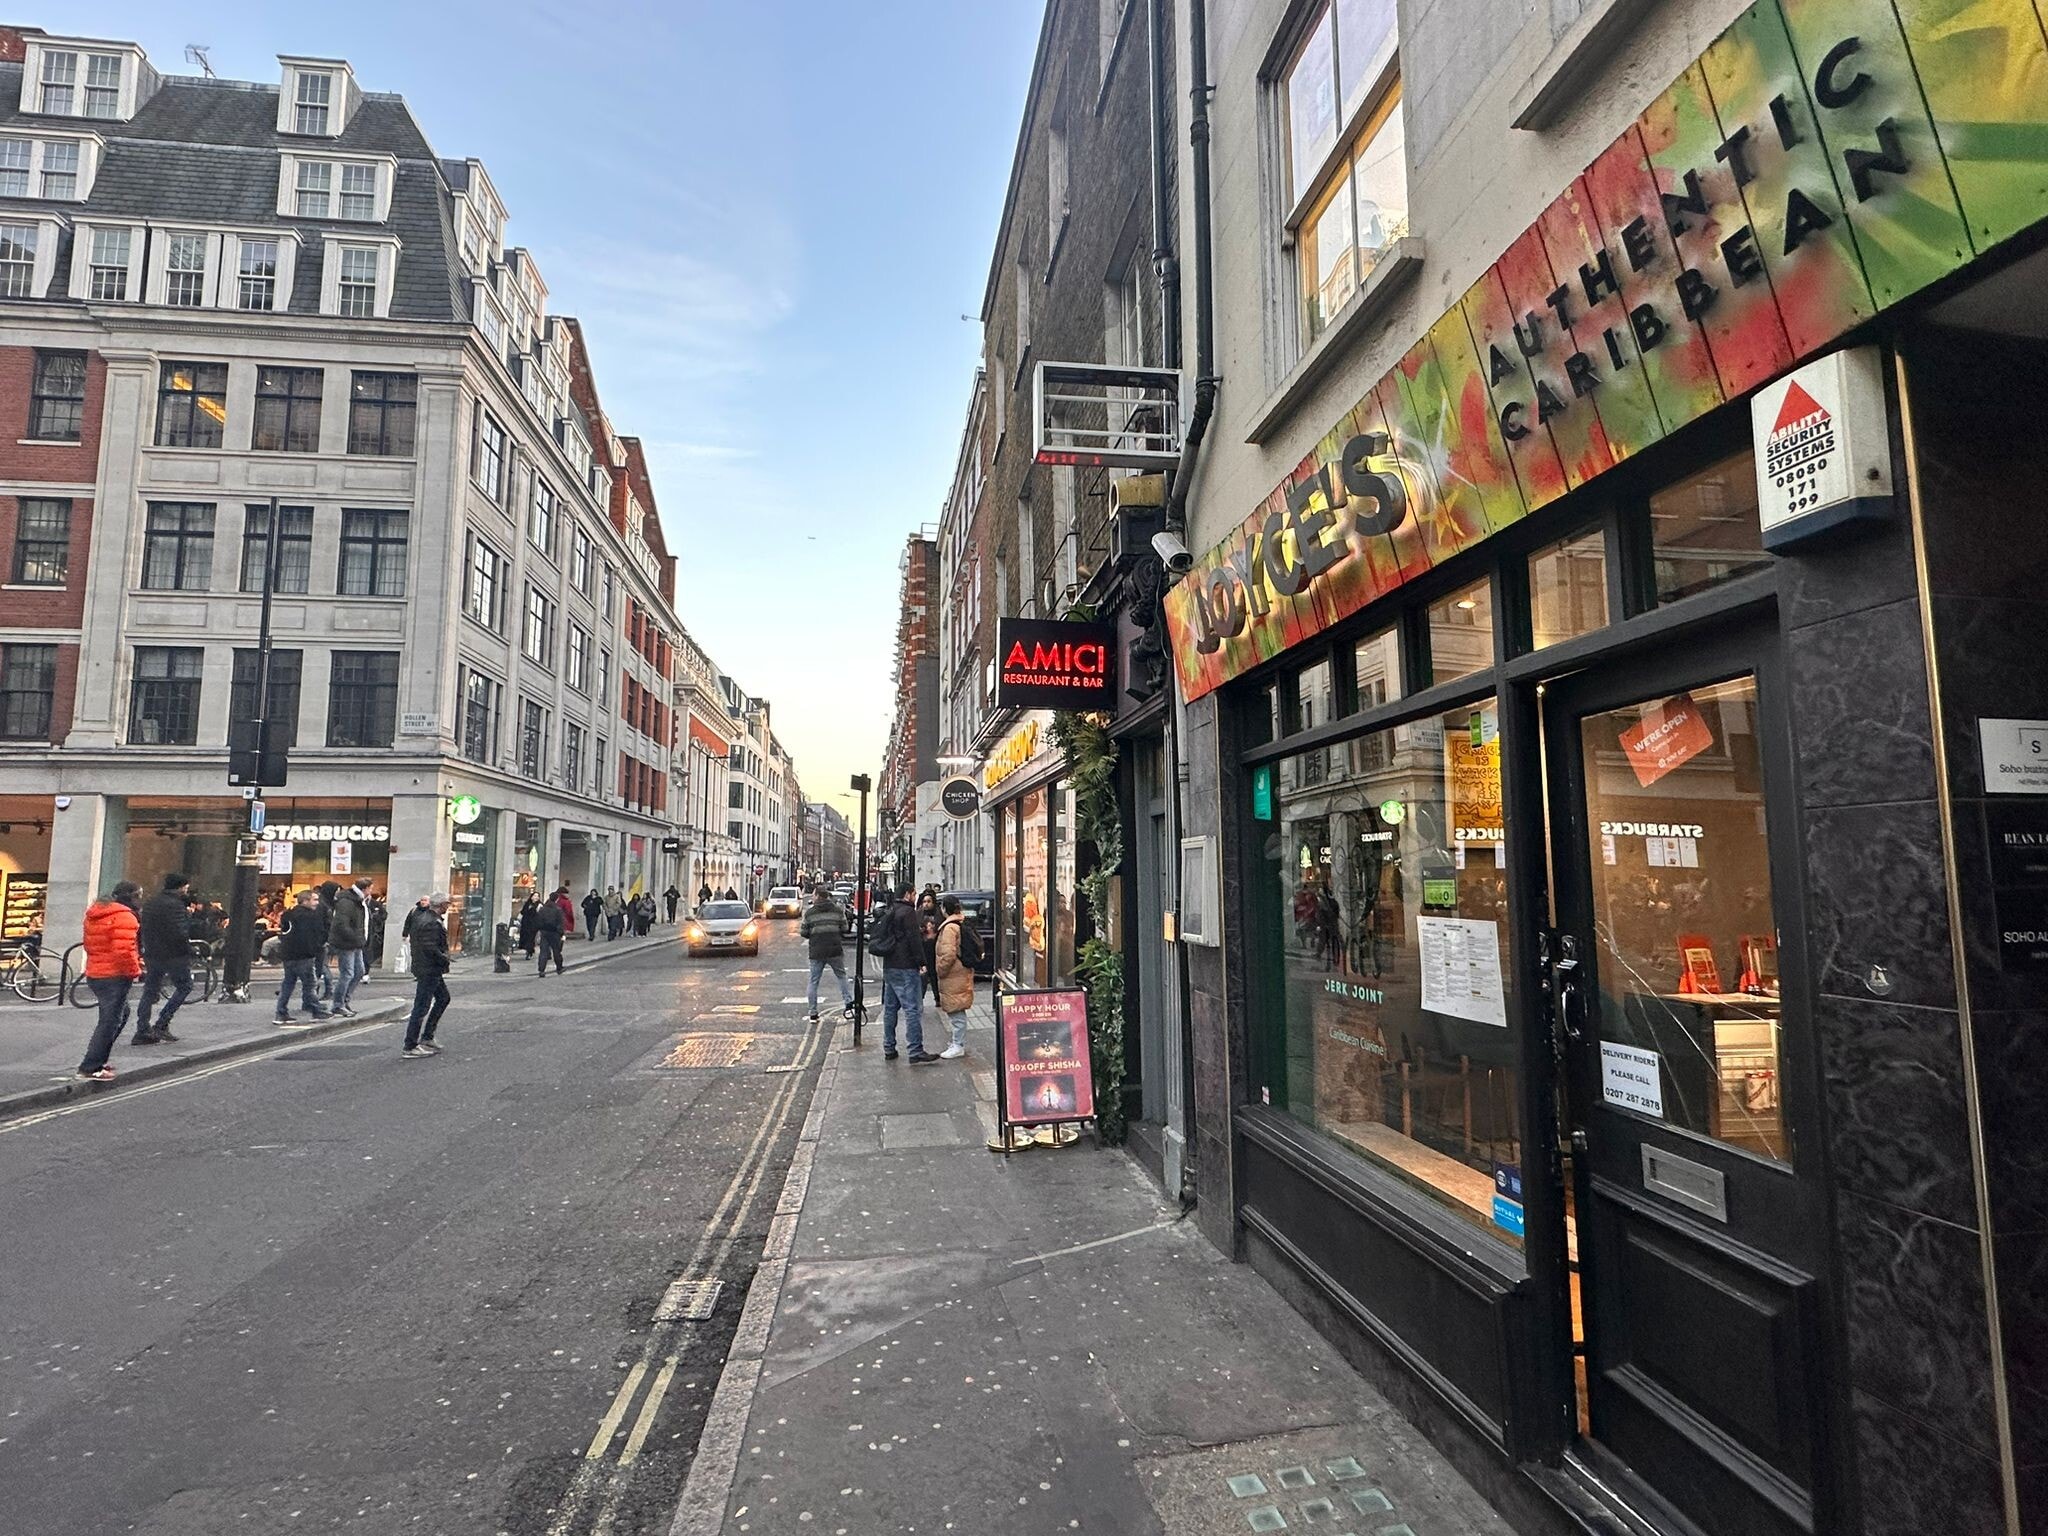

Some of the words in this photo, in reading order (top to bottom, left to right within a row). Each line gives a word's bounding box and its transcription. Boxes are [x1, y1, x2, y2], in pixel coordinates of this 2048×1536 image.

[1489, 36, 1872, 387] AUTHENTIC
[1501, 117, 1908, 441] CARIBBEAN
[1769, 409, 1825, 443] ABILITY
[1767, 418, 1831, 458] SECURITY
[1768, 435, 1835, 474] SYSTEMS
[1776, 458, 1828, 488] 08080
[1788, 478, 1817, 498] 171
[1788, 493, 1818, 513] 999
[1196, 431, 1406, 654] JOYCE'S
[1004, 640, 1104, 673] AMICI
[1003, 673, 1070, 687] RESTAURANT
[1072, 677, 1081, 687] &
[1083, 677, 1103, 688] BAR
[1661, 711, 1689, 733] OPEN
[2032, 740, 2041, 753] S
[1475, 756, 1489, 766] IS
[1999, 764, 2022, 773] Soho
[1459, 767, 1498, 779] WACK
[261, 825, 389, 841] STARBUCKS
[2004, 932, 2035, 943] SOHO
[1324, 979, 1348, 996] JERK
[1352, 985, 1383, 1004] JOINT
[1011, 1004, 1044, 1014] HAPPY
[1045, 1003, 1071, 1012] HOUR
[1048, 1060, 1082, 1070] SHISHA
[1602, 1048, 1632, 1060] DELIVERY
[1633, 1055, 1656, 1067] RIDERS
[1610, 1069, 1634, 1081] PLEASE
[1635, 1076, 1650, 1086] CALL
[1605, 1087, 1623, 1098] 0207
